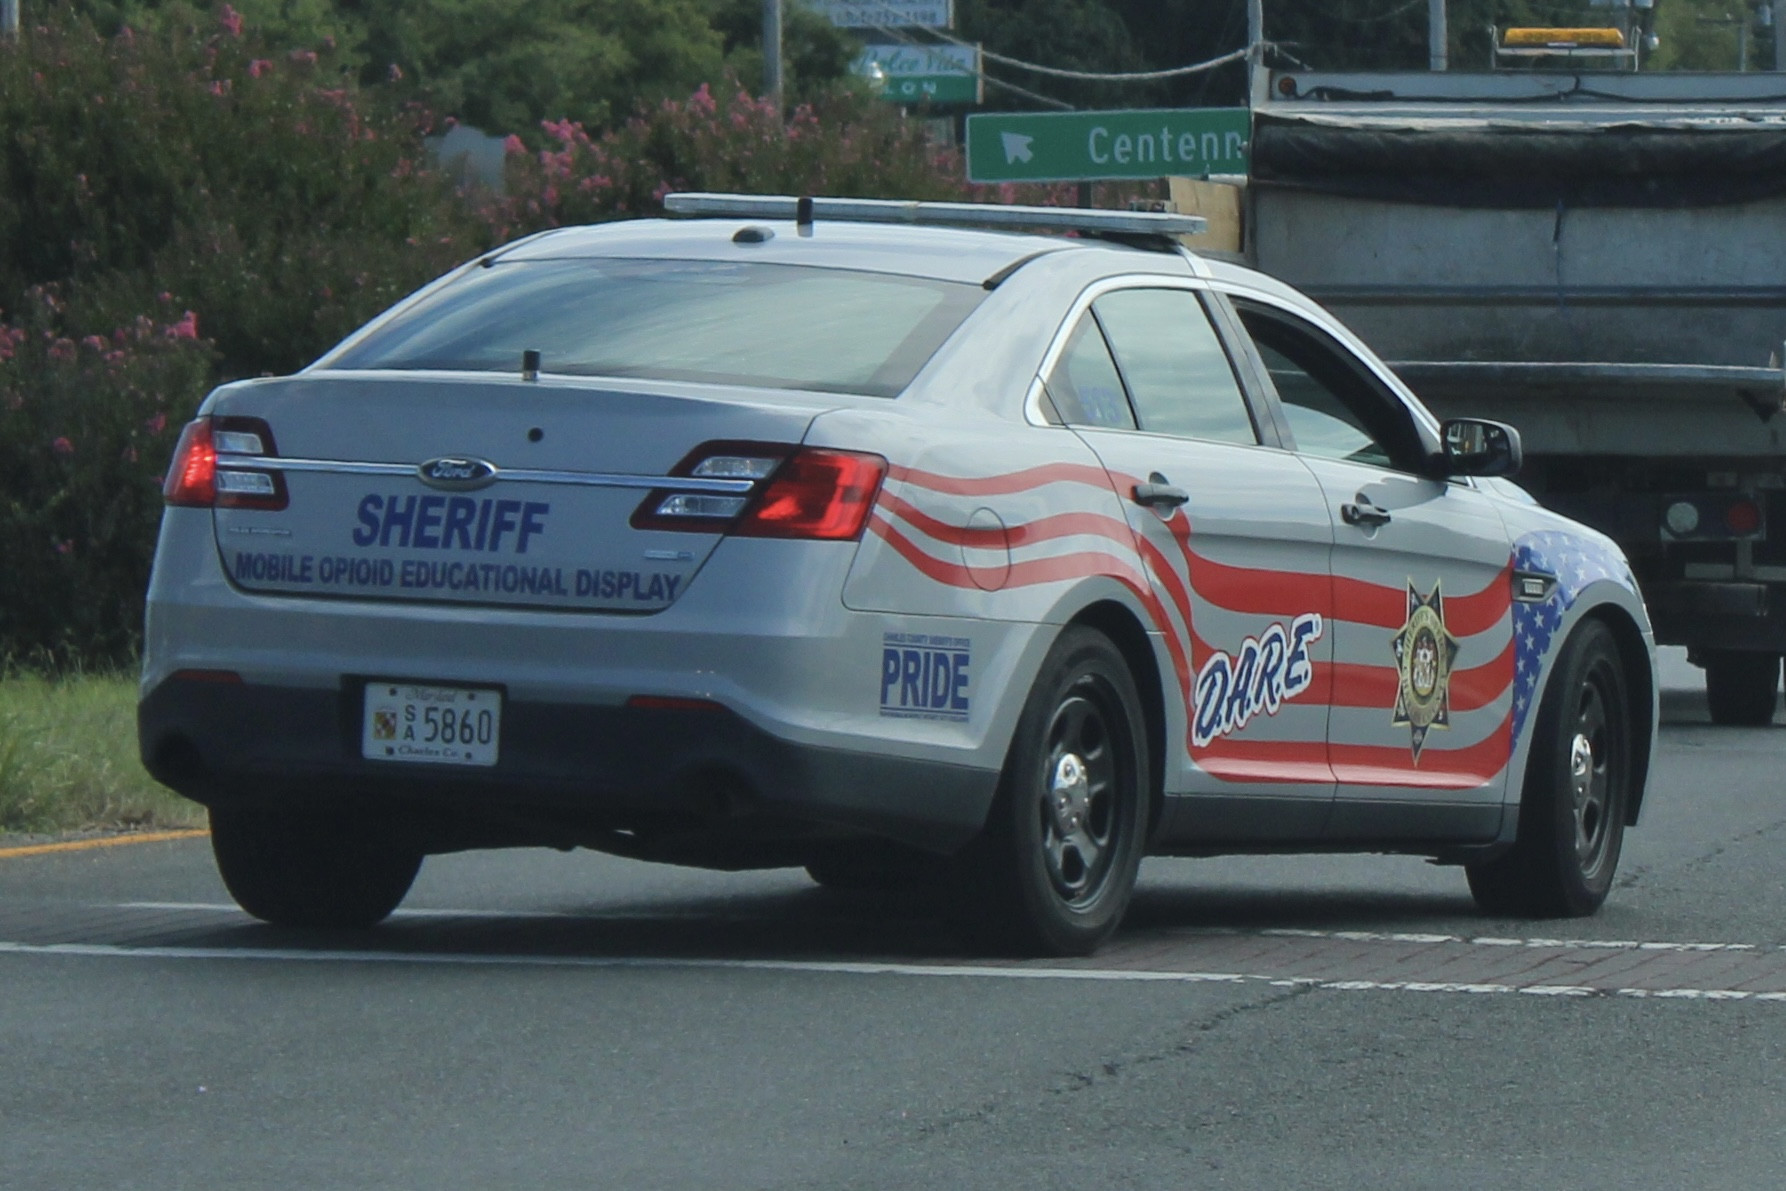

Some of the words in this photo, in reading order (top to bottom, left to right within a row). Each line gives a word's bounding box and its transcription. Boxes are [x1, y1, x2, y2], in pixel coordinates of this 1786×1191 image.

[1088, 126, 1243, 164] Centenn
[432, 458, 476, 478] Ford
[353, 493, 549, 553] SHERIFF
[235, 552, 314, 583] MOBILE
[319, 556, 393, 586] OPIOID
[400, 559, 567, 596] EDUCATIONAL
[575, 569, 681, 601] DISPLAY
[880, 649, 970, 709] PRIDE
[424, 706, 492, 745] 5860
[398, 744, 440, 756] Charles
